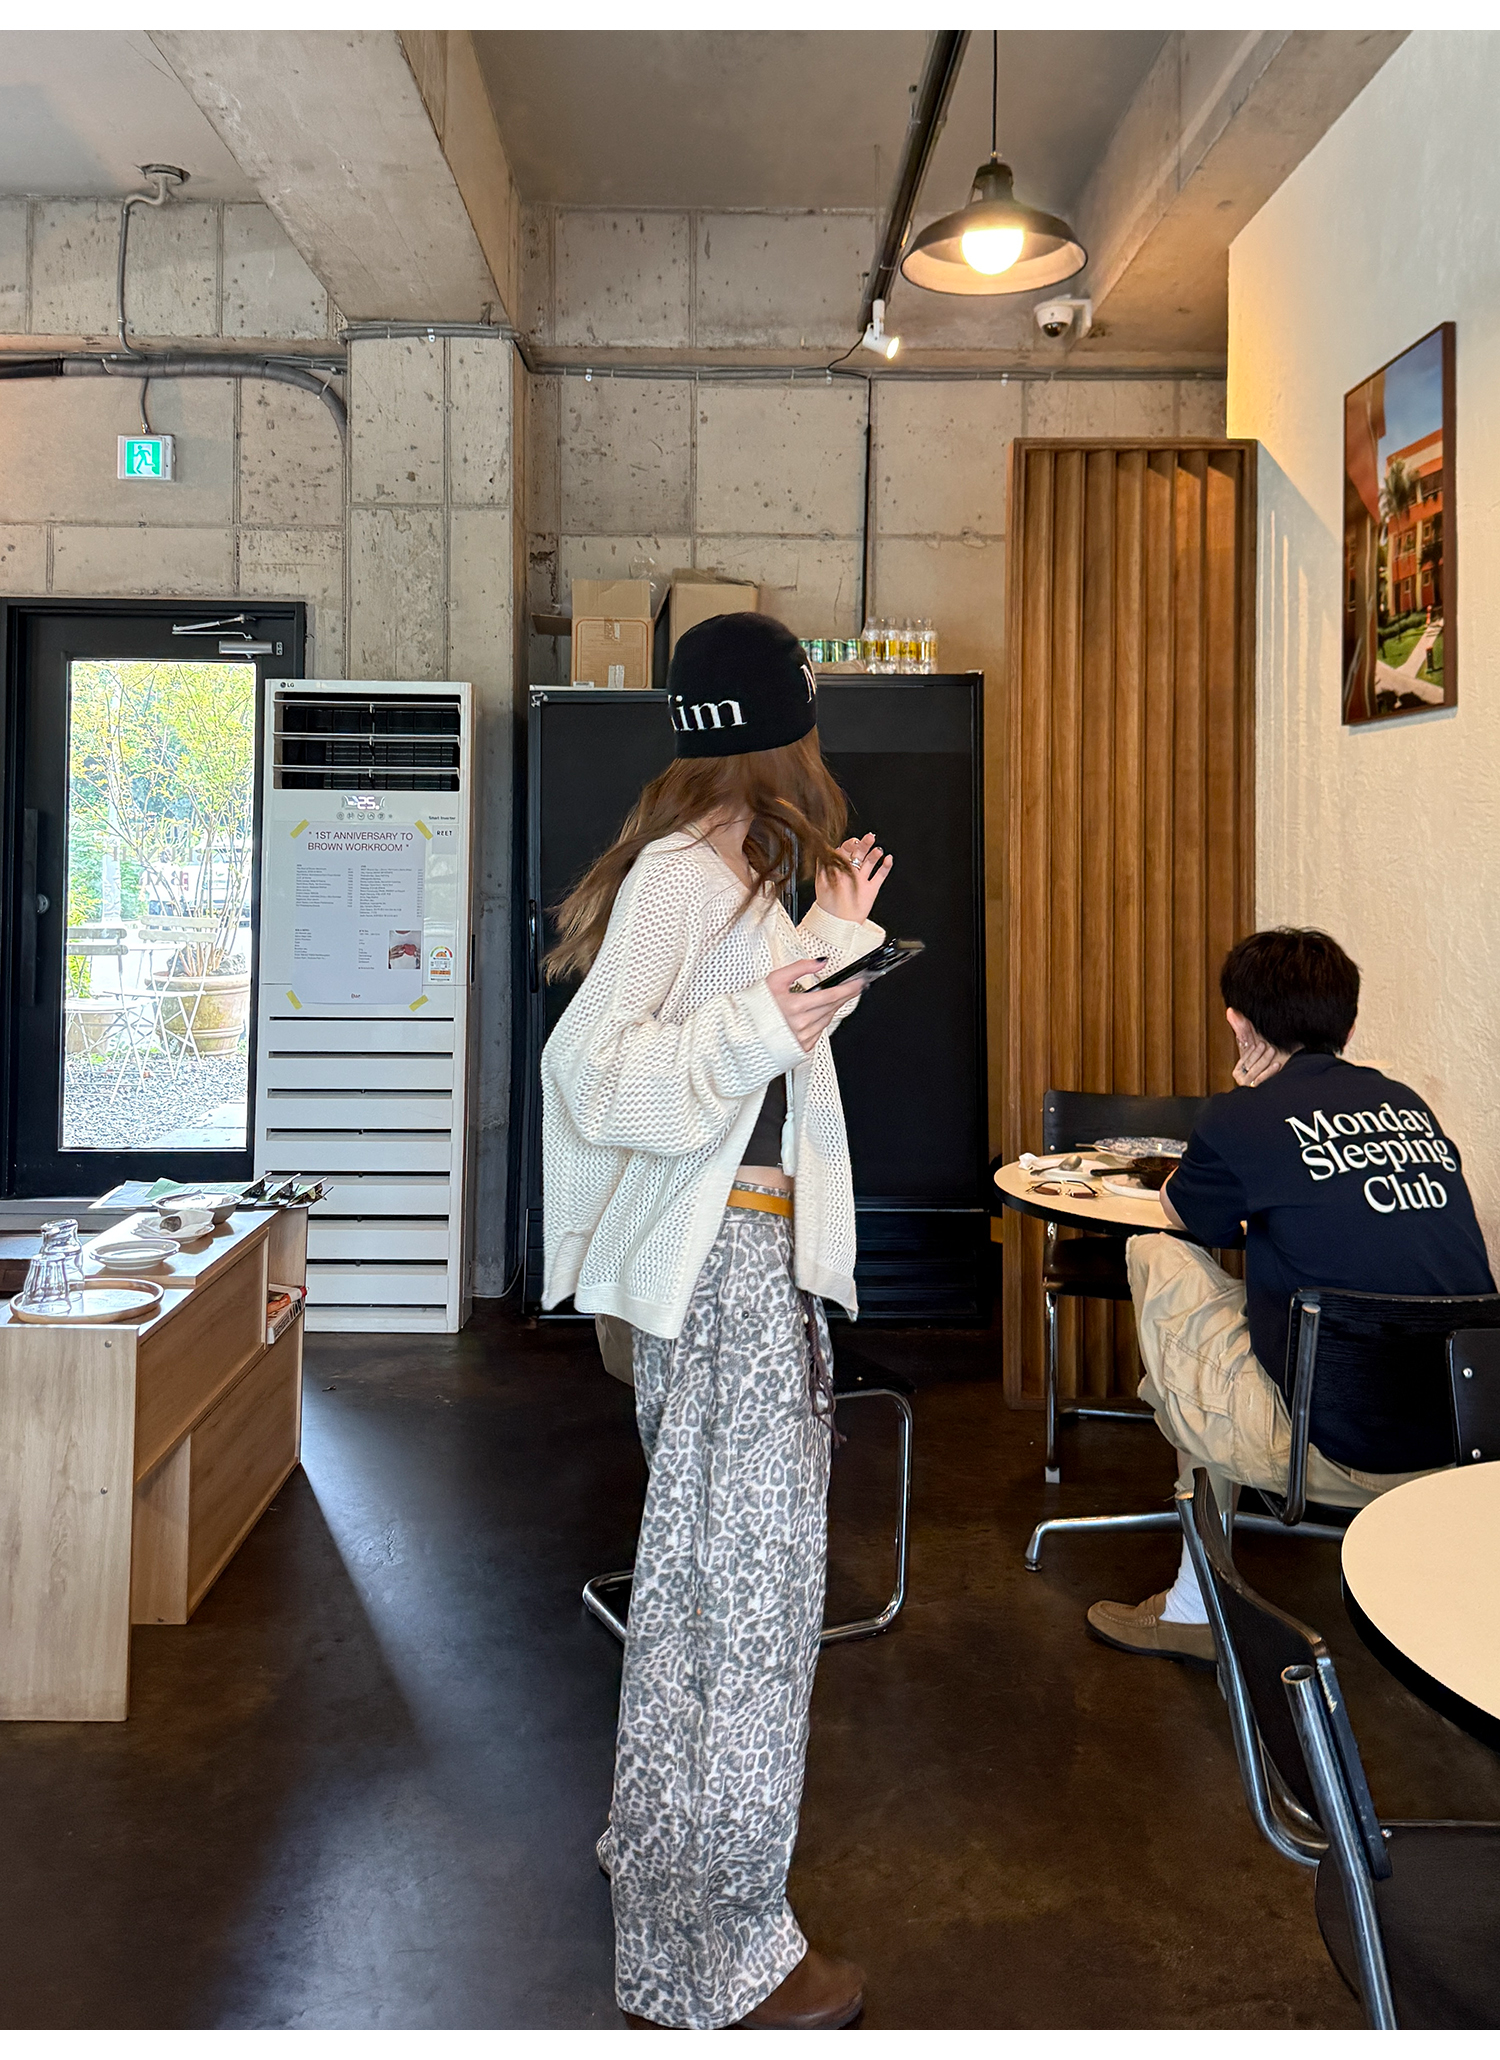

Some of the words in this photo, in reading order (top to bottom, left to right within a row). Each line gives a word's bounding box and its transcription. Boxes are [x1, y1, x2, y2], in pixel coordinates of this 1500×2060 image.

[667, 694, 748, 732] im
[307, 842, 343, 851] BROWN
[345, 842, 403, 852] WORKROOM
[315, 831, 332, 840] 1ST
[333, 831, 398, 841] ANNIVERSARY
[400, 832, 414, 841] TO
[1285, 1102, 1435, 1148] Monday
[1301, 1133, 1457, 1181] Sleeping
[1363, 1172, 1448, 1214] Club
